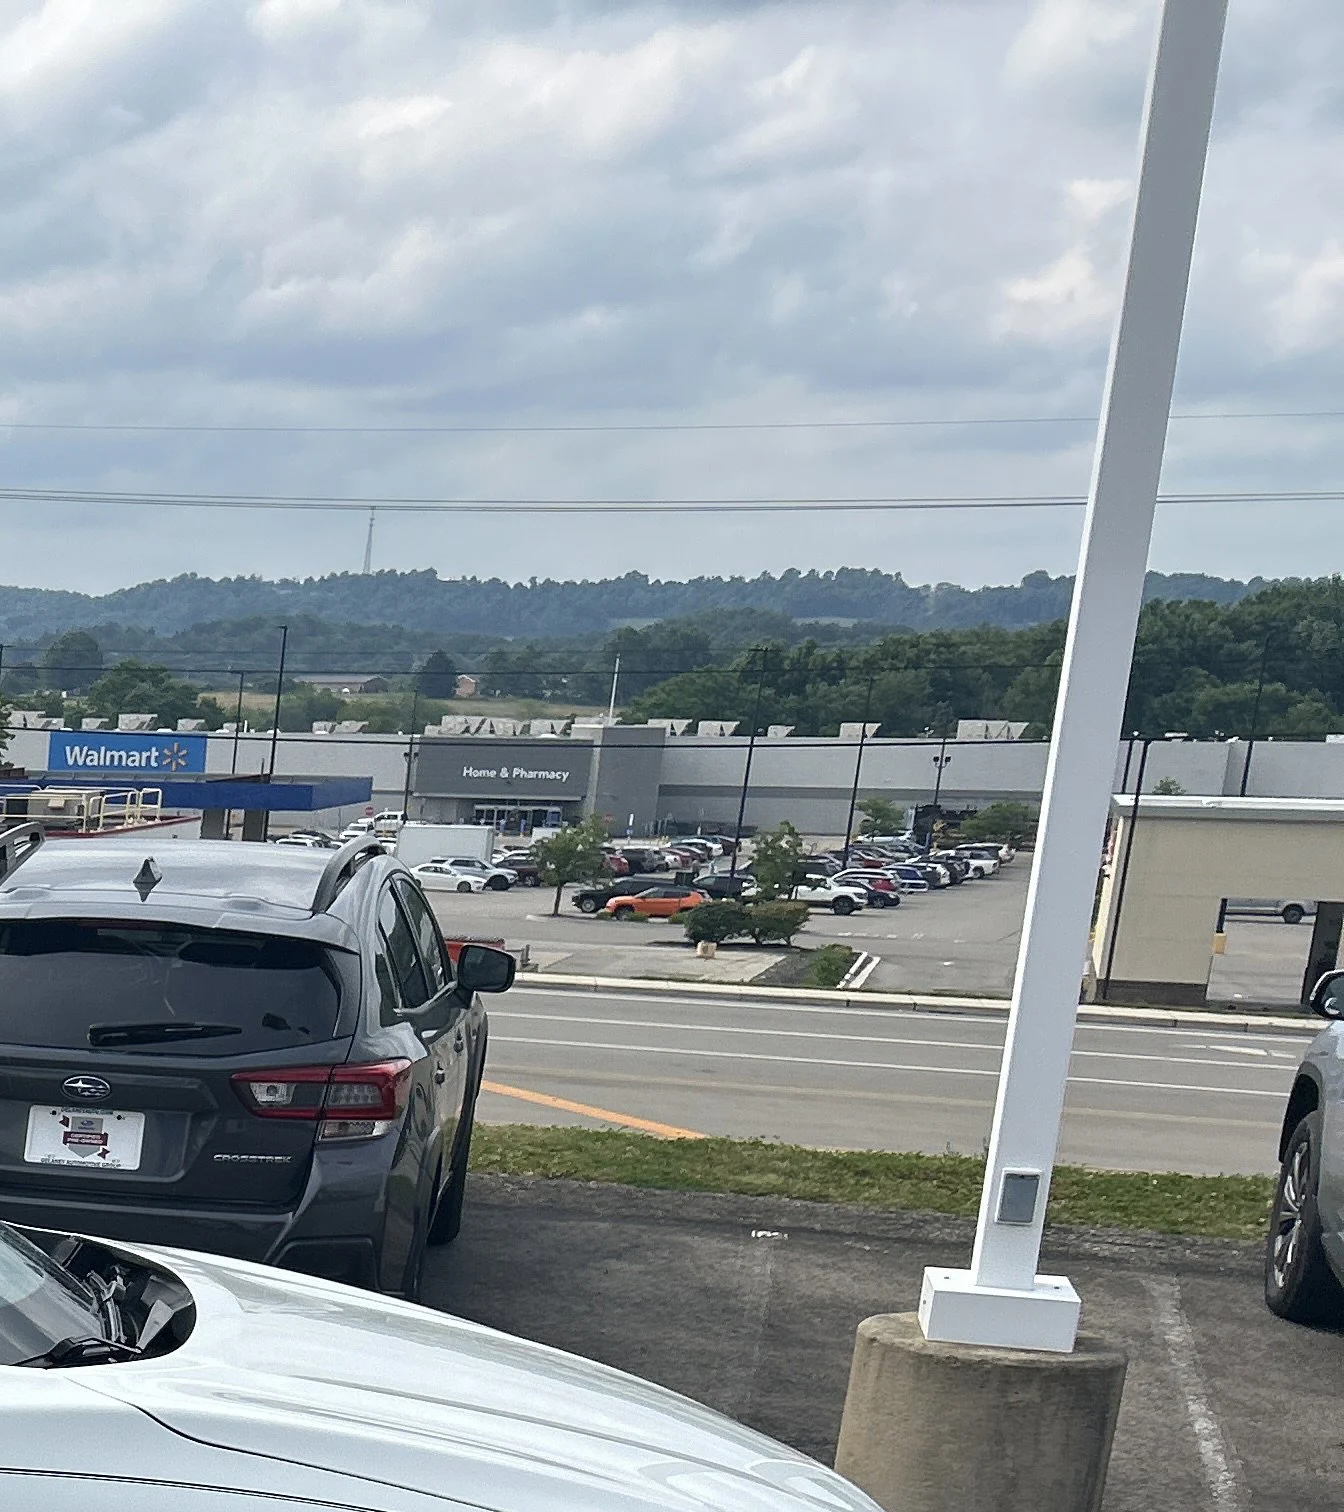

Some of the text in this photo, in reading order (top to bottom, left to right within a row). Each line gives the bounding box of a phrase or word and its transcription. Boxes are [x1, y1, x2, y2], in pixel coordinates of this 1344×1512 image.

[65, 745, 159, 767] Walmart
[463, 766, 570, 782] Home & Pharmacy
[213, 1154, 292, 1164] CROSSTREK
